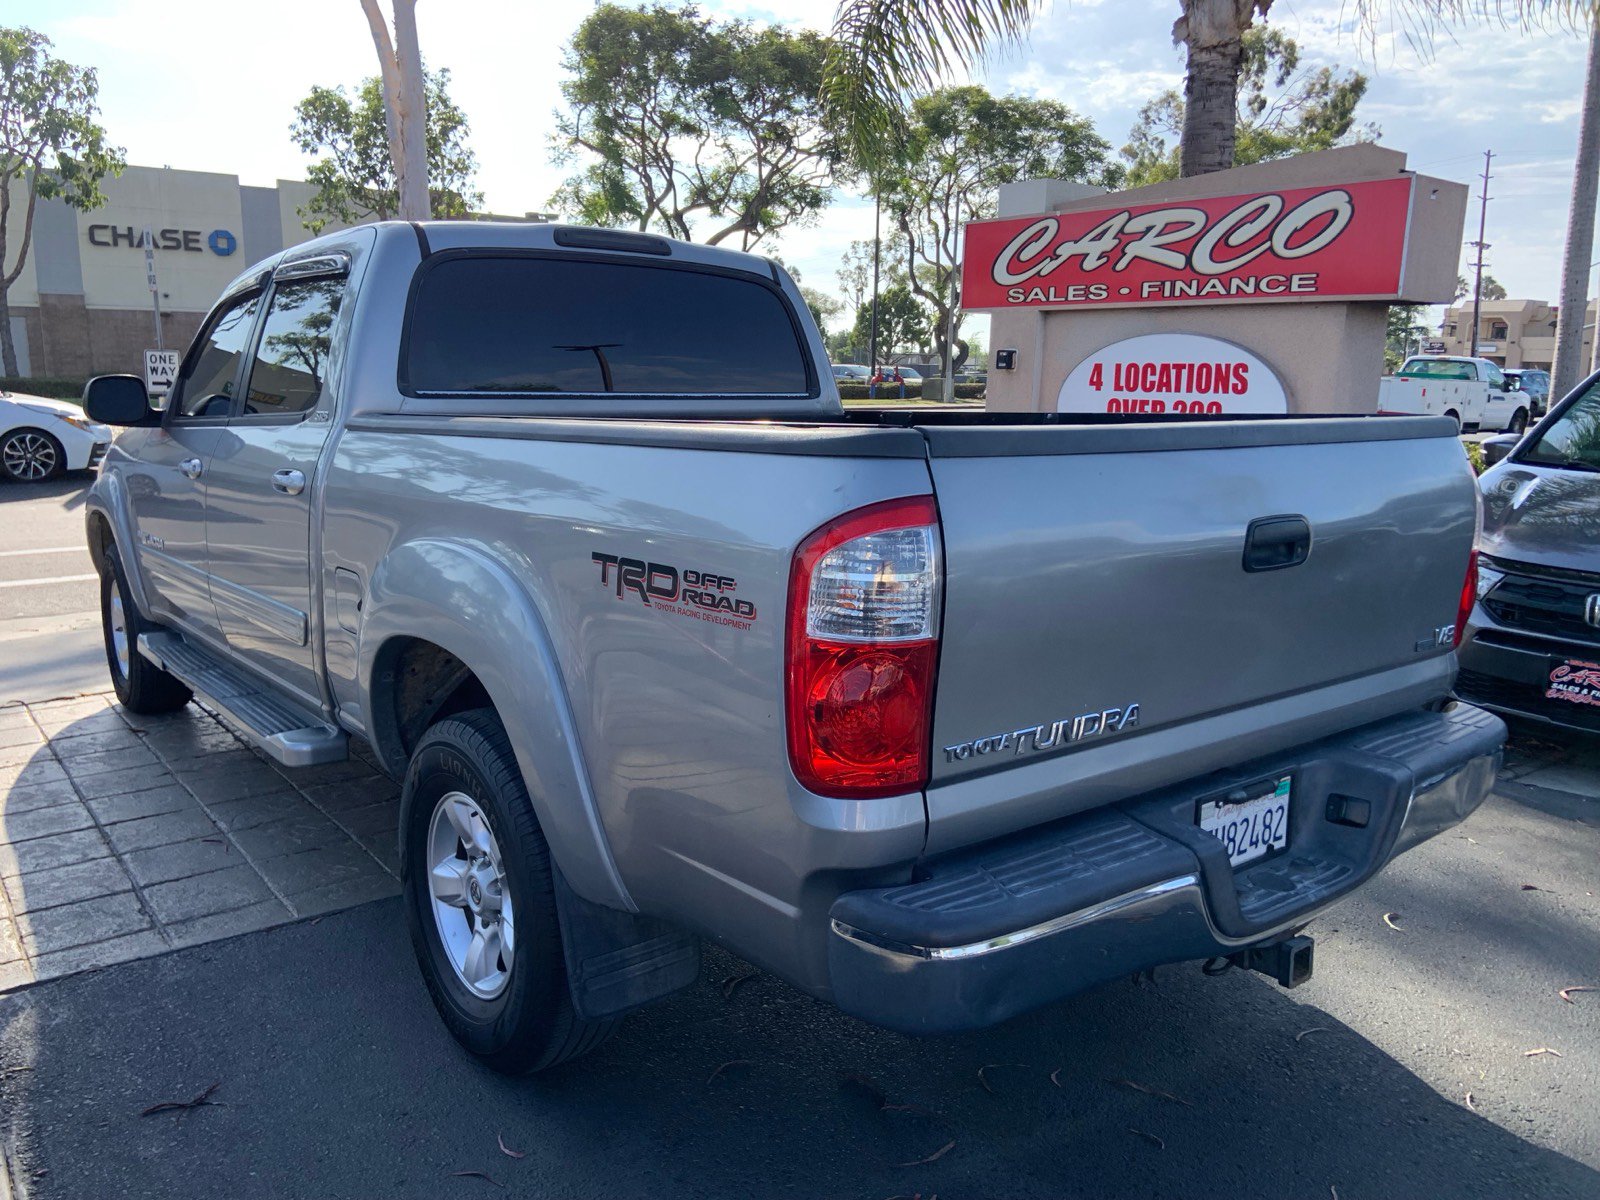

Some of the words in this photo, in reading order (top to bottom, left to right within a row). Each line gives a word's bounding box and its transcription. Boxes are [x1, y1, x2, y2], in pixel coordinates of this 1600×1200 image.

[88, 224, 203, 252] CHASE
[991, 188, 1354, 287] CARCO
[1006, 283, 1109, 304] SALES
[1140, 272, 1319, 298] FINANCE
[149, 353, 176, 365] ONE
[149, 366, 177, 377] WAY
[1088, 362, 1104, 392] 4
[1113, 362, 1249, 395] LOCATIONS
[591, 551, 681, 608] TRD
[683, 569, 738, 593] OFF
[654, 601, 676, 614] TOYOTA
[677, 607, 701, 620] RACING
[702, 613, 752, 631] DEVELOPMENT
[681, 588, 757, 621] ROAD
[1551, 682, 1580, 693] SALES
[944, 733, 1010, 764] TOYOTA
[1012, 703, 1140, 756] TUNDRA
